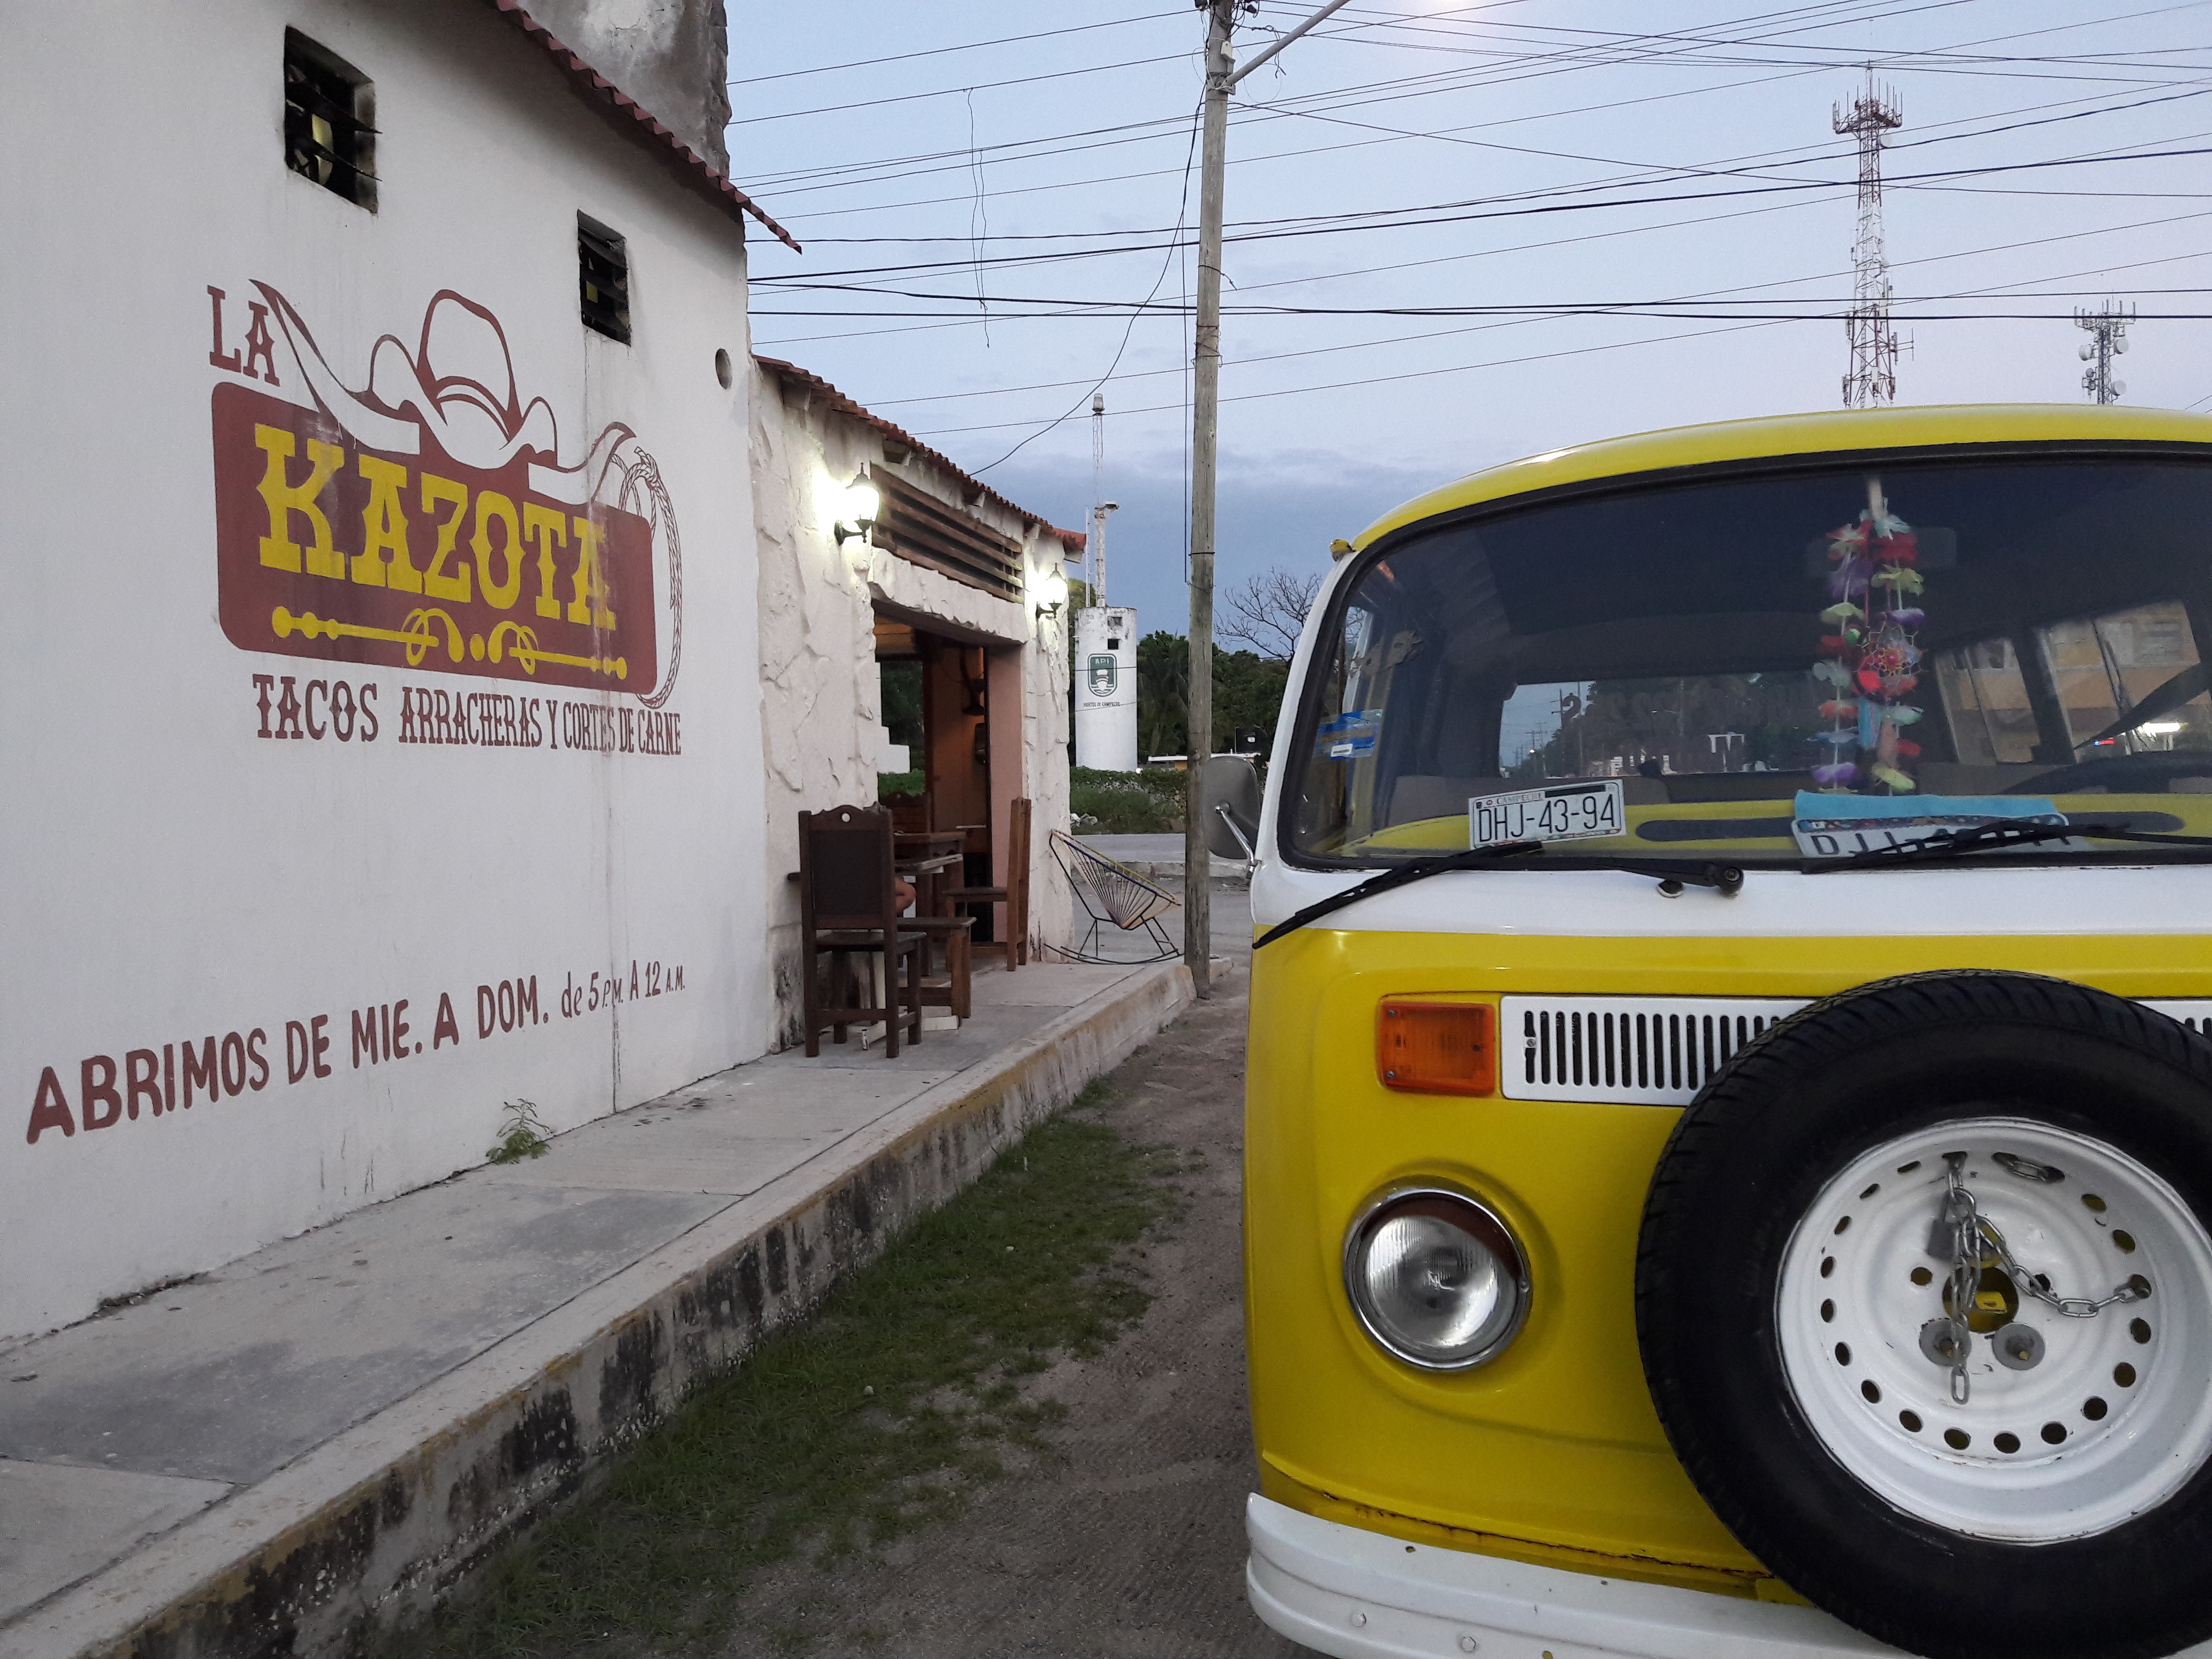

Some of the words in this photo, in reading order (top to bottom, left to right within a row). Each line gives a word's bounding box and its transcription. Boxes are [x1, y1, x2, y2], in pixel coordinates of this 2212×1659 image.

[207, 285, 280, 387] LA
[255, 423, 616, 630] KAZOTA
[253, 674, 378, 742] TACOS
[399, 687, 542, 748] ARRACHERAS
[546, 700, 558, 749] Y
[563, 701, 616, 751] CORTES
[618, 707, 634, 753] DE
[638, 709, 681, 756] CARNE
[1479, 794, 1615, 842] DHJ-43-94
[26, 1028, 270, 1145] ABRIMOS
[286, 1015, 331, 1085] DE
[352, 999, 422, 1069] MIE.
[434, 992, 459, 1050] A
[477, 975, 549, 1040] DOM.
[562, 971, 582, 1018] de
[630, 960, 639, 1001] A
